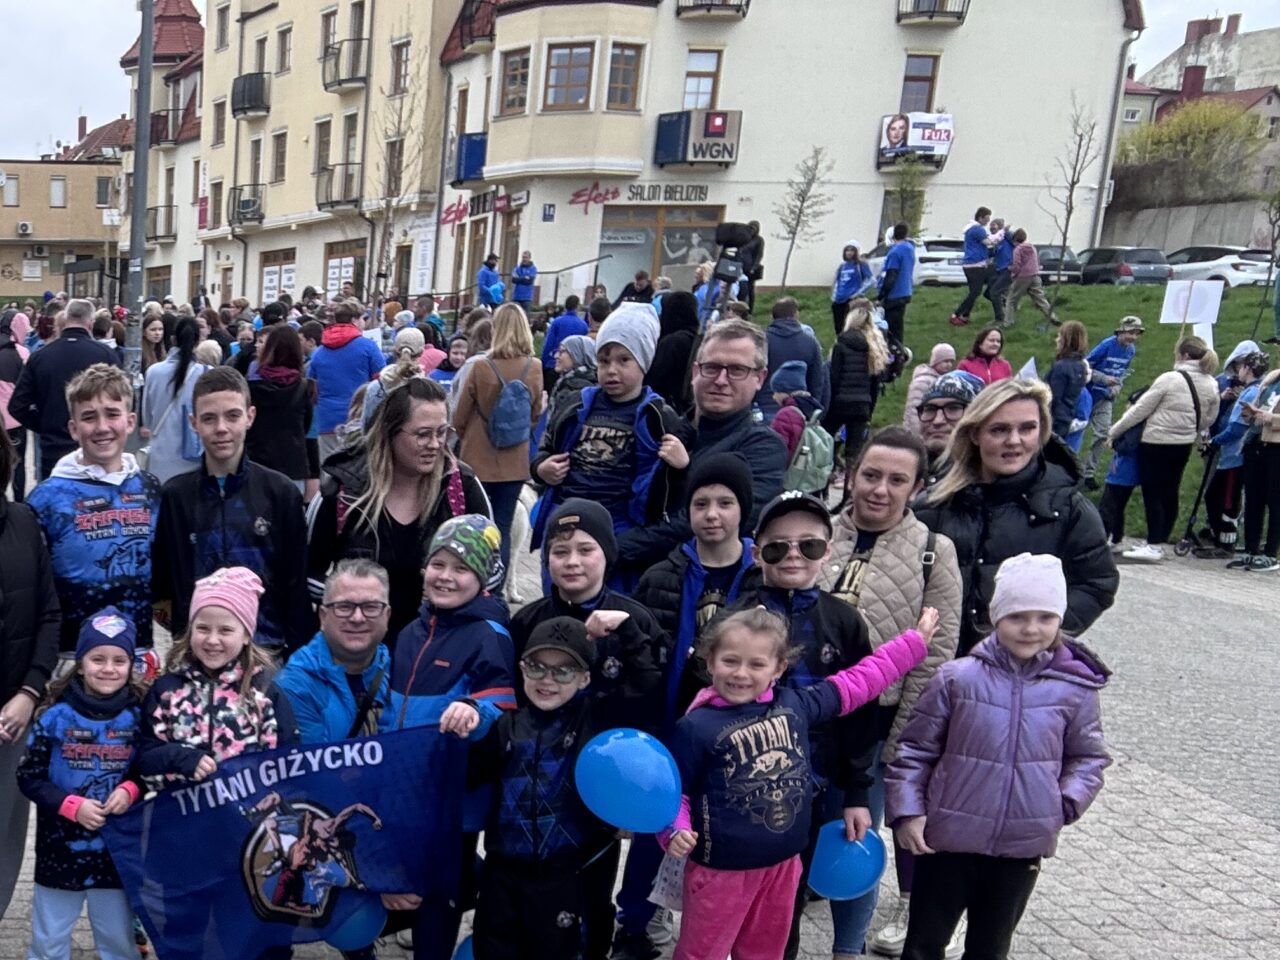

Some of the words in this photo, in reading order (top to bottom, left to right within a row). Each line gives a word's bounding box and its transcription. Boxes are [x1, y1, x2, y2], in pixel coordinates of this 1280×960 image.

[692, 142, 734, 159] WGN
[627, 184, 661, 201] SALON
[730, 715, 793, 764] TYTANI
[171, 768, 256, 815] TYTANI
[258, 740, 384, 787] GIŻYCKO
